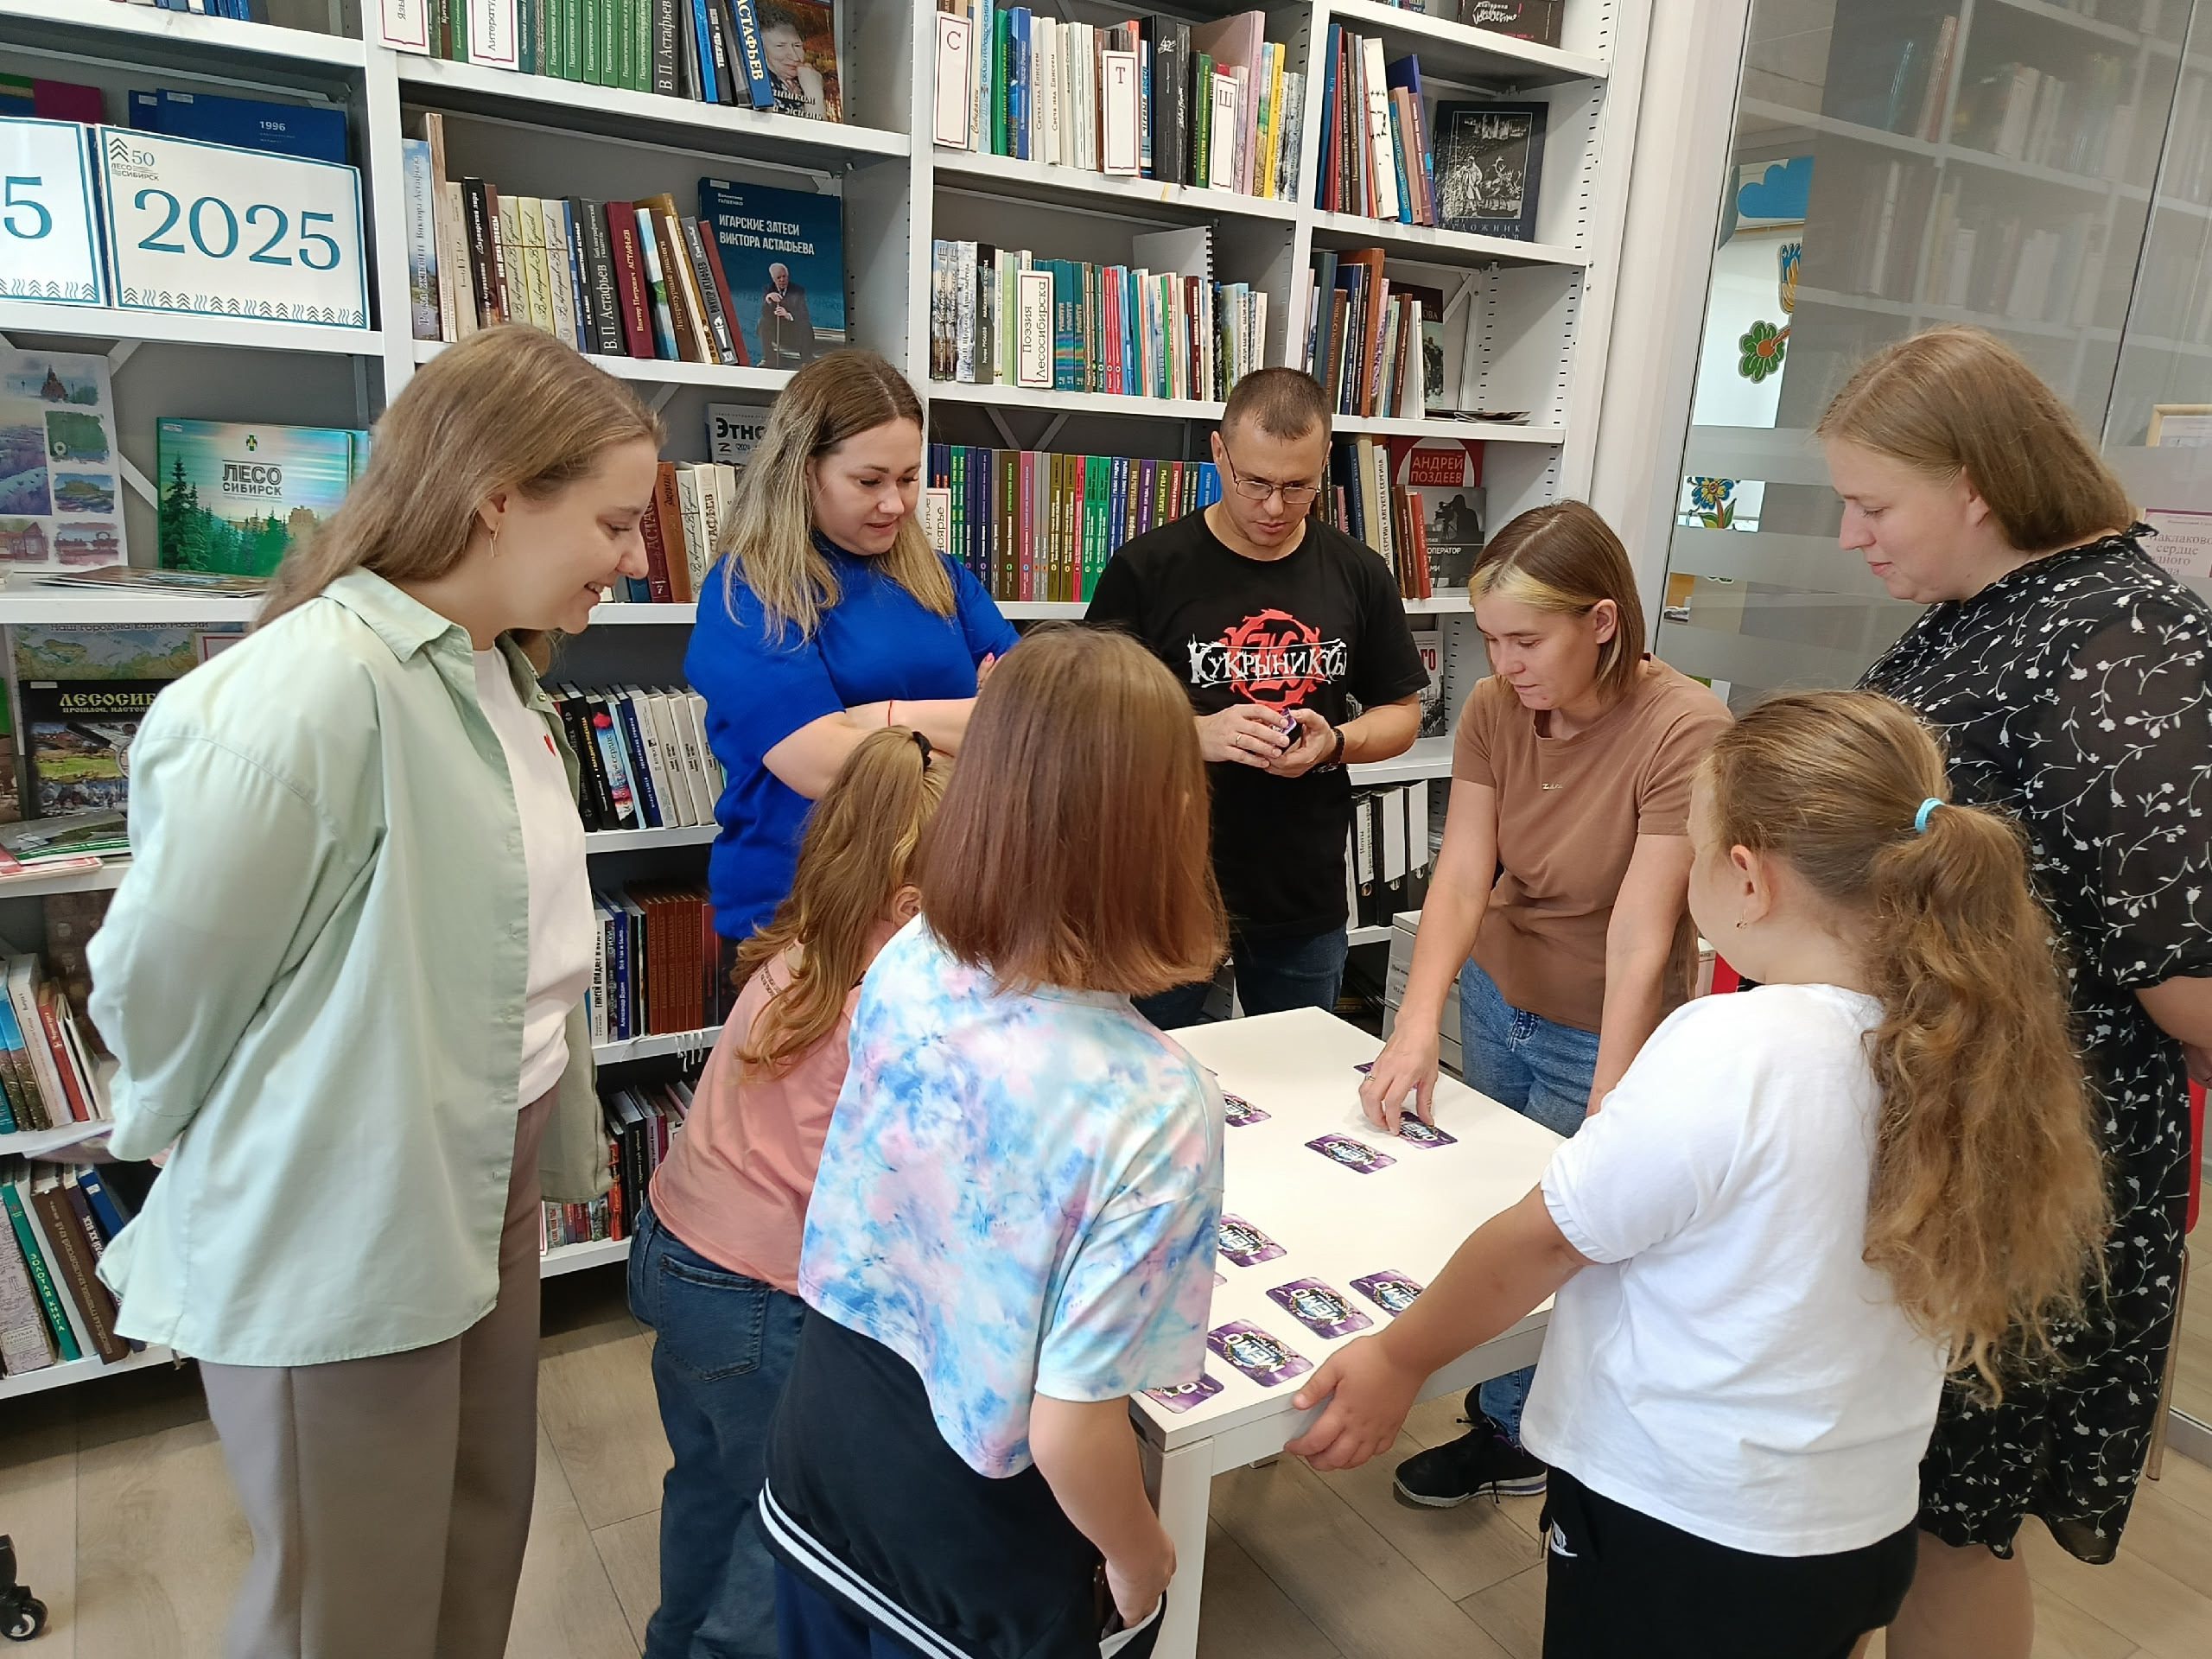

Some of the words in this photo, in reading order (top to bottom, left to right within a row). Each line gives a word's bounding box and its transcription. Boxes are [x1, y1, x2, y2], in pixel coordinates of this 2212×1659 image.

[658, 1, 676, 59] Астафьев
[946, 30, 961, 50] С
[658, 79, 672, 90] В.
[1115, 67, 1127, 85] Т
[259, 120, 286, 131] 1996
[111, 162, 132, 171] ЛЕСО
[131, 149, 155, 167] 50
[121, 169, 159, 181] СИБИРСК
[134, 188, 341, 270] 2025
[719, 213, 765, 232] ИГАРСКИЕ
[766, 219, 800, 236] ЗАТЕСИ
[623, 229, 635, 270] АСТАФЬЕВ
[720, 232, 760, 248] ВИКТОРА
[762, 238, 815, 256] АСТАФЬЕВА
[660, 239, 673, 273] диалоги
[496, 263, 505, 278] МОЙ
[698, 261, 716, 292] АСТАФЬЕВ
[595, 264, 614, 320] Астафьев
[631, 271, 641, 305] Петрович
[666, 274, 684, 331] Литературные
[703, 291, 721, 314] ВИКТОР
[601, 322, 615, 335] П.
[634, 307, 644, 331] Виктор
[1022, 306, 1033, 353] Поэзия
[1036, 281, 1047, 378] Лесосибирска
[603, 338, 617, 350] В.
[1413, 454, 1463, 470] АНДРЕЙ
[222, 463, 283, 485] ЛЕСО
[1159, 469, 1167, 486] ГОРЫ
[1410, 471, 1463, 484] ПОЗДЕЕВ
[222, 482, 283, 496] СИБИРСК
[1128, 470, 1138, 510] НОСТАЛЬГИЯ
[1157, 487, 1166, 513] ЗЛАТЫЕ
[703, 493, 718, 553] СТАФЬЕВ
[1401, 1122, 1438, 1141] ЕМО
[54, 1220, 67, 1239] КРАЙ
[29, 1251, 52, 1299] ЗОЛОТАЯ
[47, 1299, 66, 1333] КНИГА
